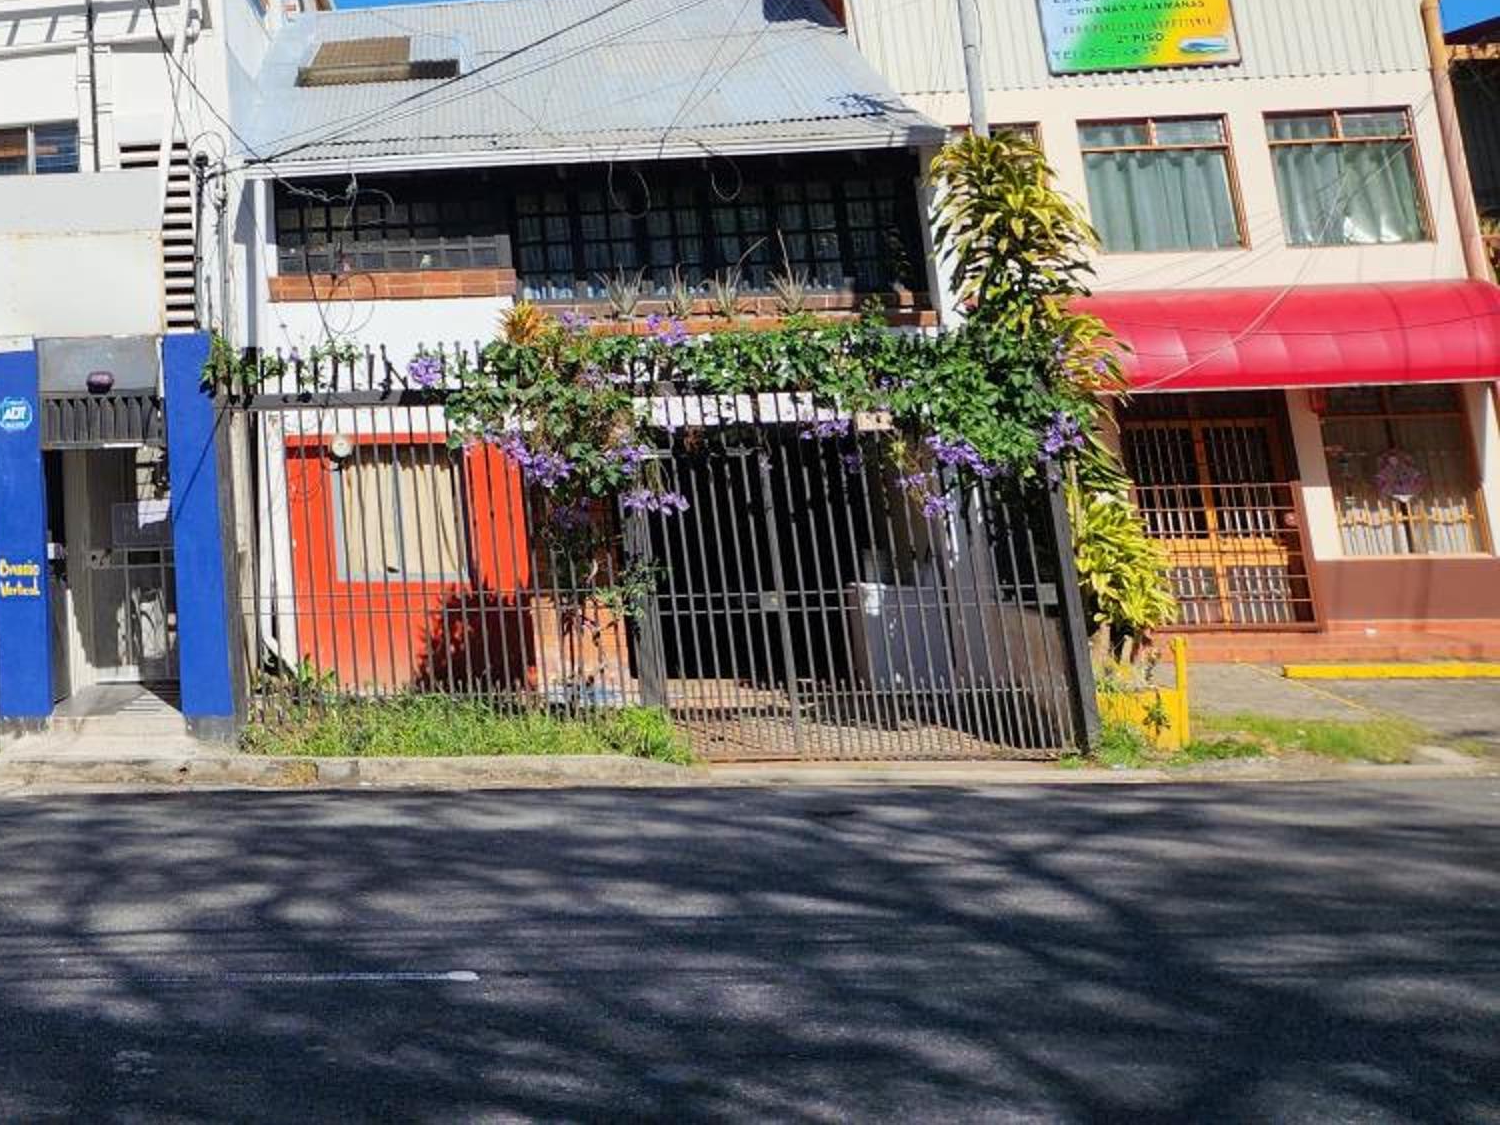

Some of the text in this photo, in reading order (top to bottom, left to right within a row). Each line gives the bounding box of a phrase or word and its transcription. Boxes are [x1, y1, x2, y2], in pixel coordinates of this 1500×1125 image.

[1067, 4, 1125, 15] CHILENAS
[1141, 0, 1204, 11] ALEMANAS
[1132, 32, 1164, 44] PISO
[3, 406, 27, 420] ADT
